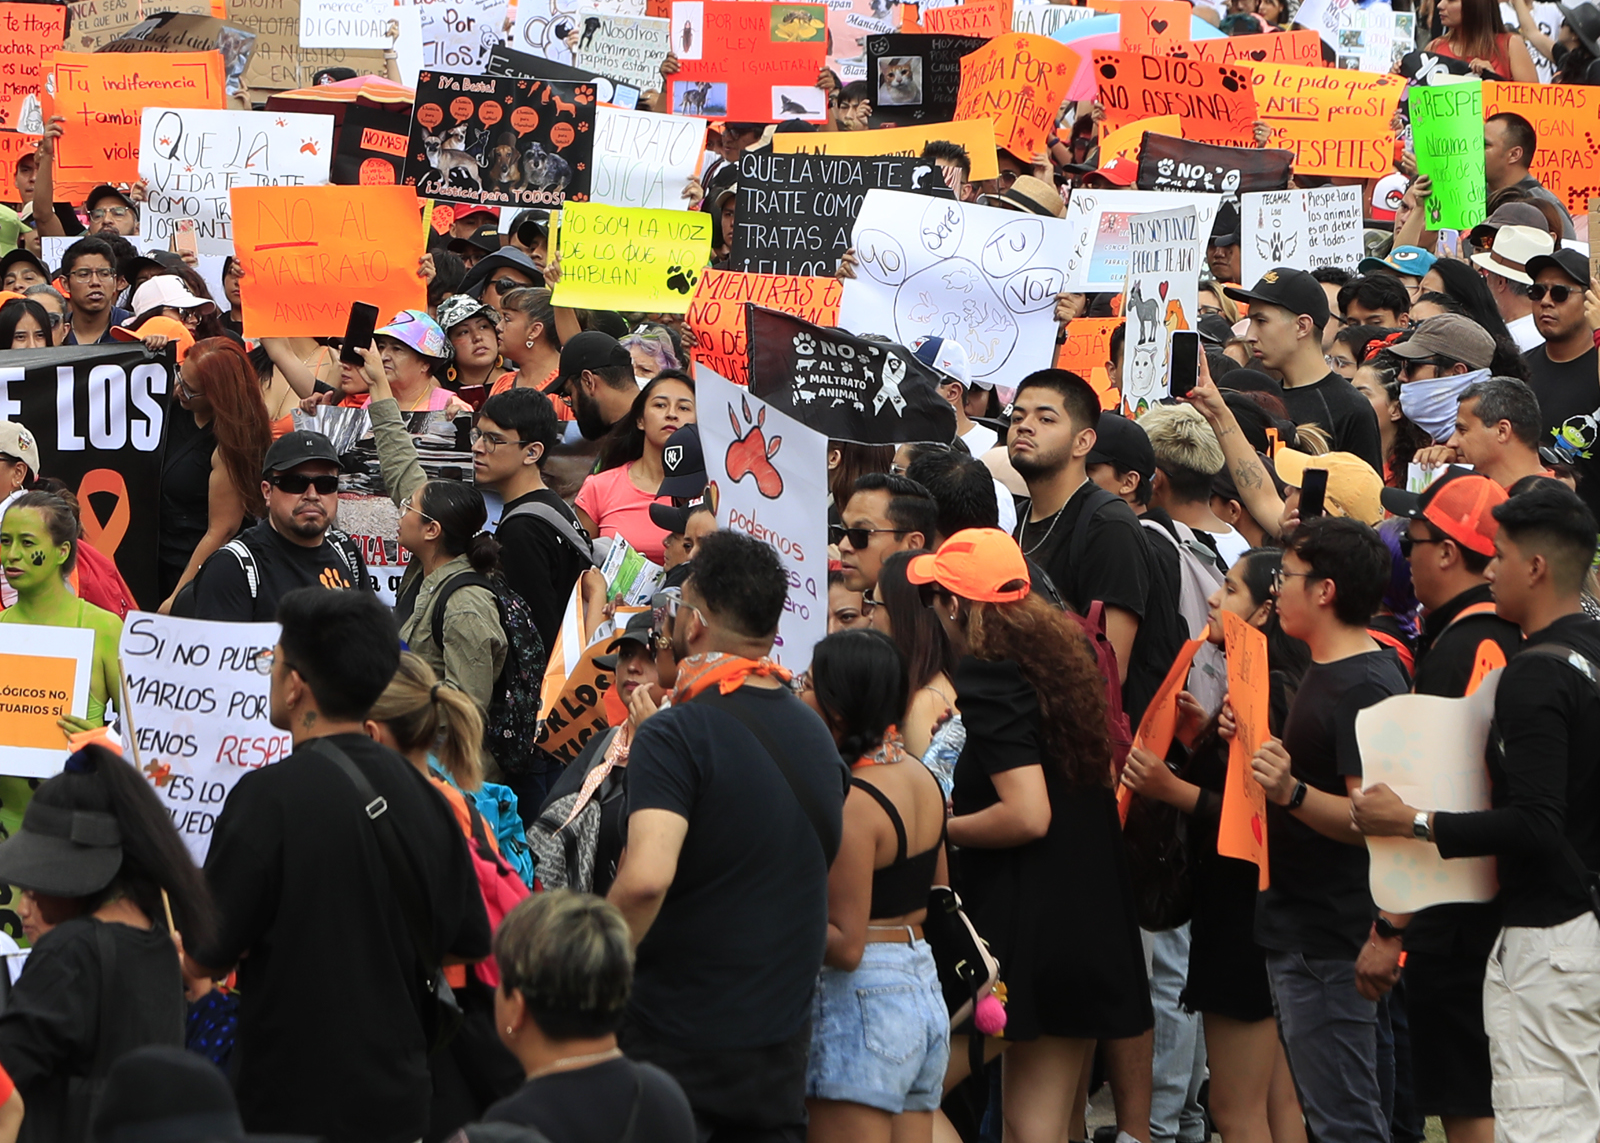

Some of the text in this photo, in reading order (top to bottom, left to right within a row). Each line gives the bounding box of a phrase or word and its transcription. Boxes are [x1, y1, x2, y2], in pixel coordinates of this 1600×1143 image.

[103, 0, 128, 13] SEAS
[3, 13, 19, 30] te
[23, 14, 62, 37] Haga
[78, 13, 131, 31] EL QUE UN
[602, 19, 660, 44] Nosotros
[740, 16, 766, 31] UNA
[924, 10, 992, 33] NO RAZA
[594, 40, 640, 59] venimos
[932, 38, 955, 51] HOY
[2, 62, 16, 75] es
[1142, 55, 1204, 88] DIOS
[102, 73, 197, 92] indiferencia
[1297, 69, 1378, 100] pido que
[1100, 84, 1232, 122] NO ASESINA
[1496, 84, 1587, 109] MIENTRAS
[1266, 96, 1361, 123] AMES pero
[153, 110, 218, 170] QUE
[362, 131, 380, 146] NO
[741, 153, 902, 187] QUE LA VIDA TE
[1177, 162, 1206, 181] NO
[147, 190, 200, 216] COMO
[512, 189, 566, 206] TODOS!
[741, 186, 808, 215] TRATE
[258, 198, 378, 242] NO AL
[593, 215, 708, 242] SOY LA VOZ
[738, 222, 823, 251] TRATAS
[251, 249, 390, 286] MALTRATO
[592, 242, 698, 269] LO NO
[694, 270, 815, 308] MIENTRAS
[689, 300, 722, 327] NO
[819, 339, 856, 359] NO
[819, 360, 836, 372] AL
[809, 373, 868, 391] MALTRATO
[818, 387, 860, 403] ANIMAL
[57, 363, 169, 453] LOS
[173, 644, 210, 666] NO
[49, 688, 69, 701] NO,
[228, 691, 268, 721] POR
[50, 704, 63, 717] SÍ
[168, 774, 196, 800] ES
